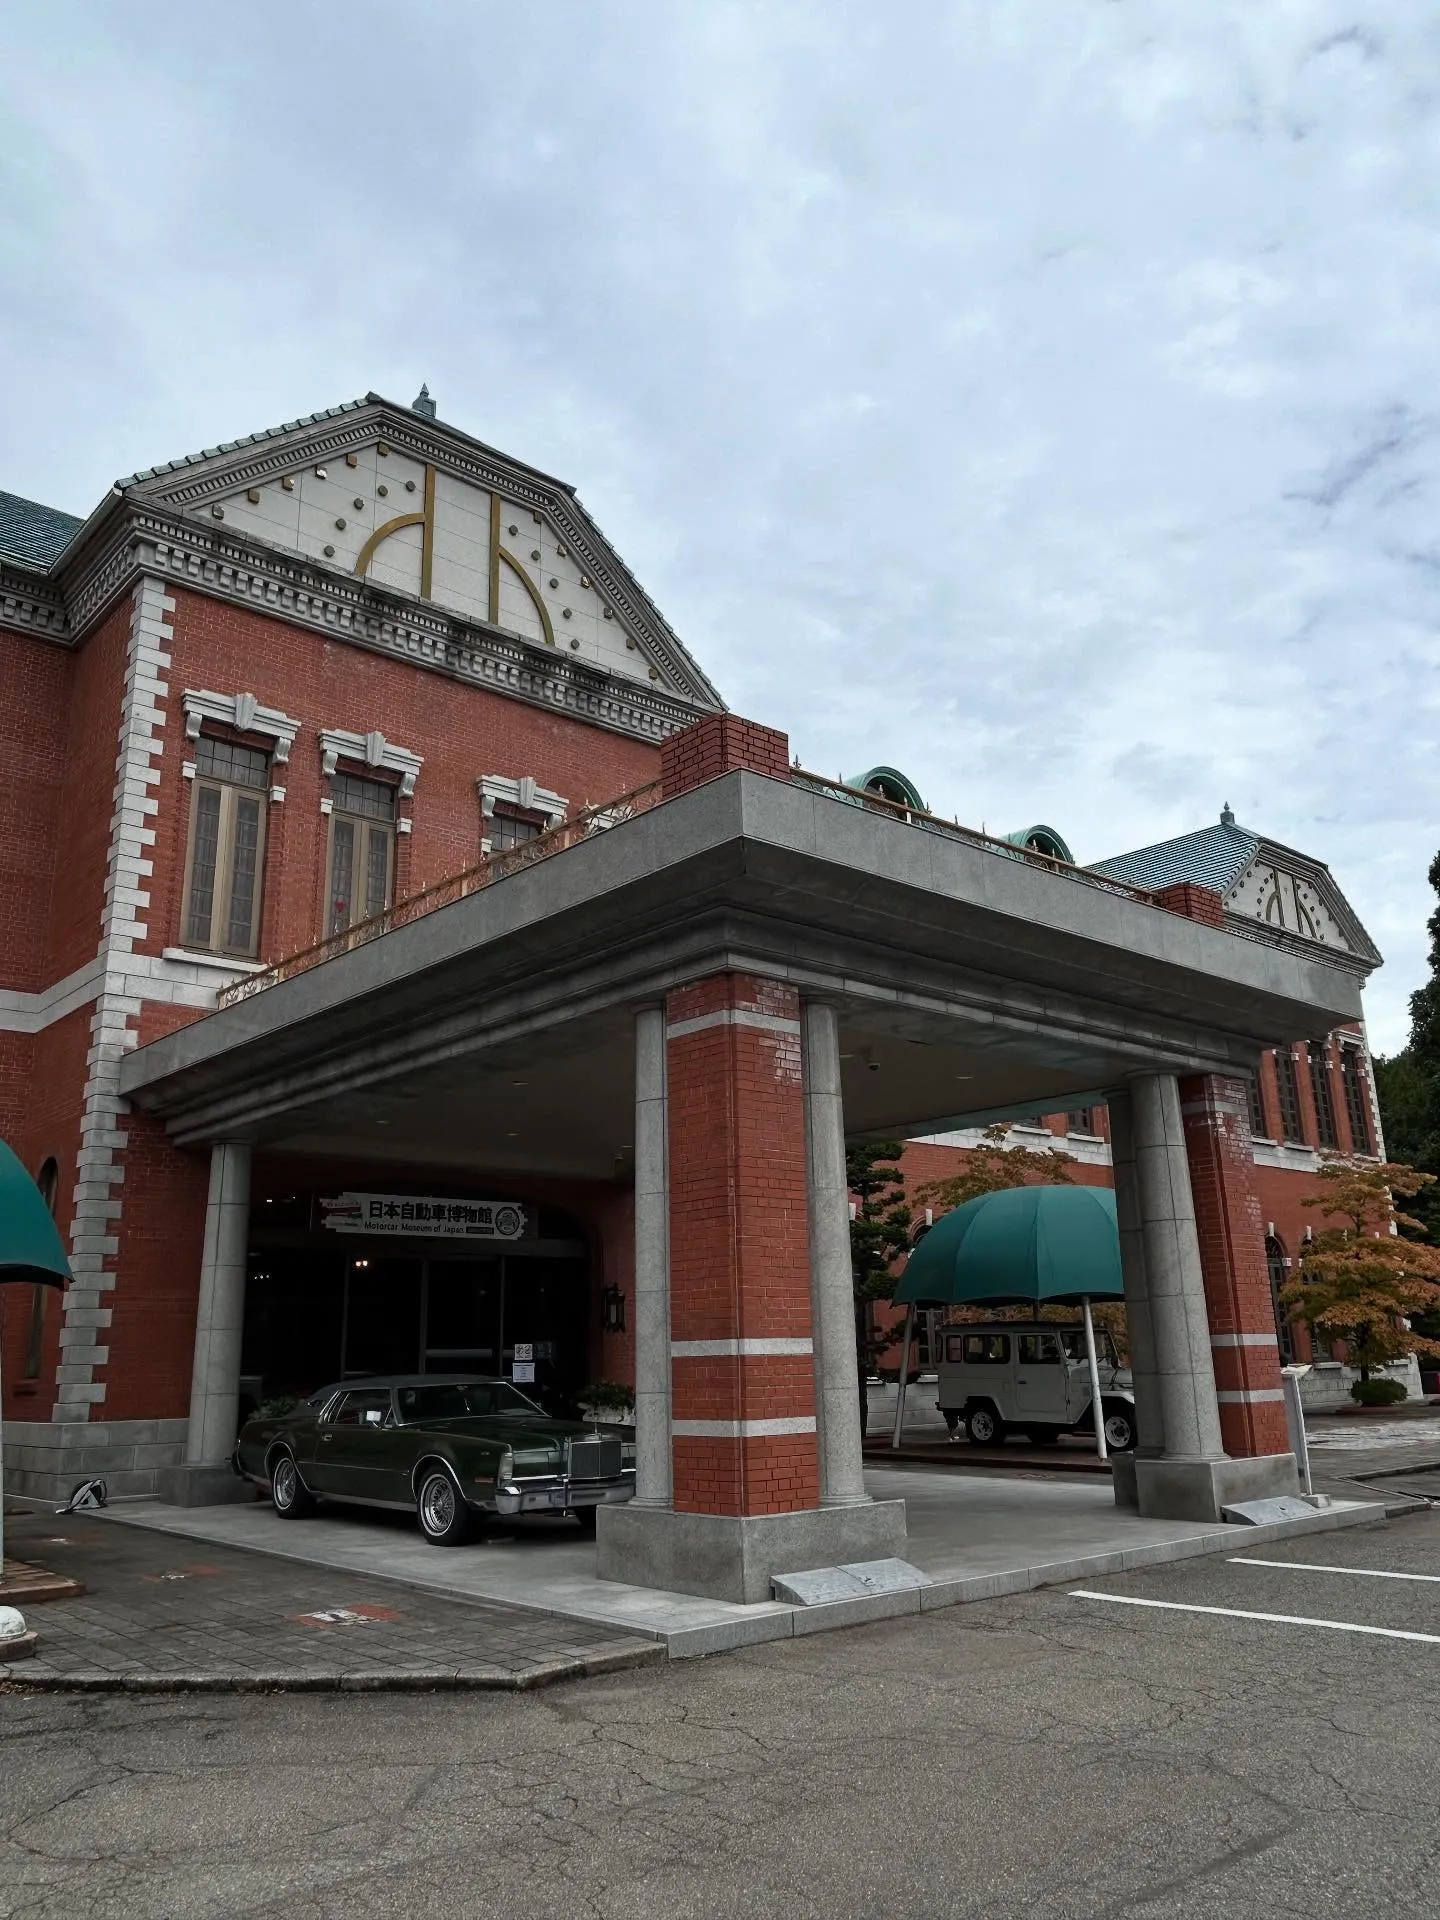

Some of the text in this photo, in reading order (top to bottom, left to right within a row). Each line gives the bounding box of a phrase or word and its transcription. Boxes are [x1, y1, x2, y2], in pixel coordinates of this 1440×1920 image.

[369, 1200, 493, 1224] 日本自動車博物館
[364, 1221, 398, 1231] Motorcar
[401, 1223, 432, 1232] Museum
[434, 1224, 441, 1233] of
[444, 1225, 464, 1236] Japan
